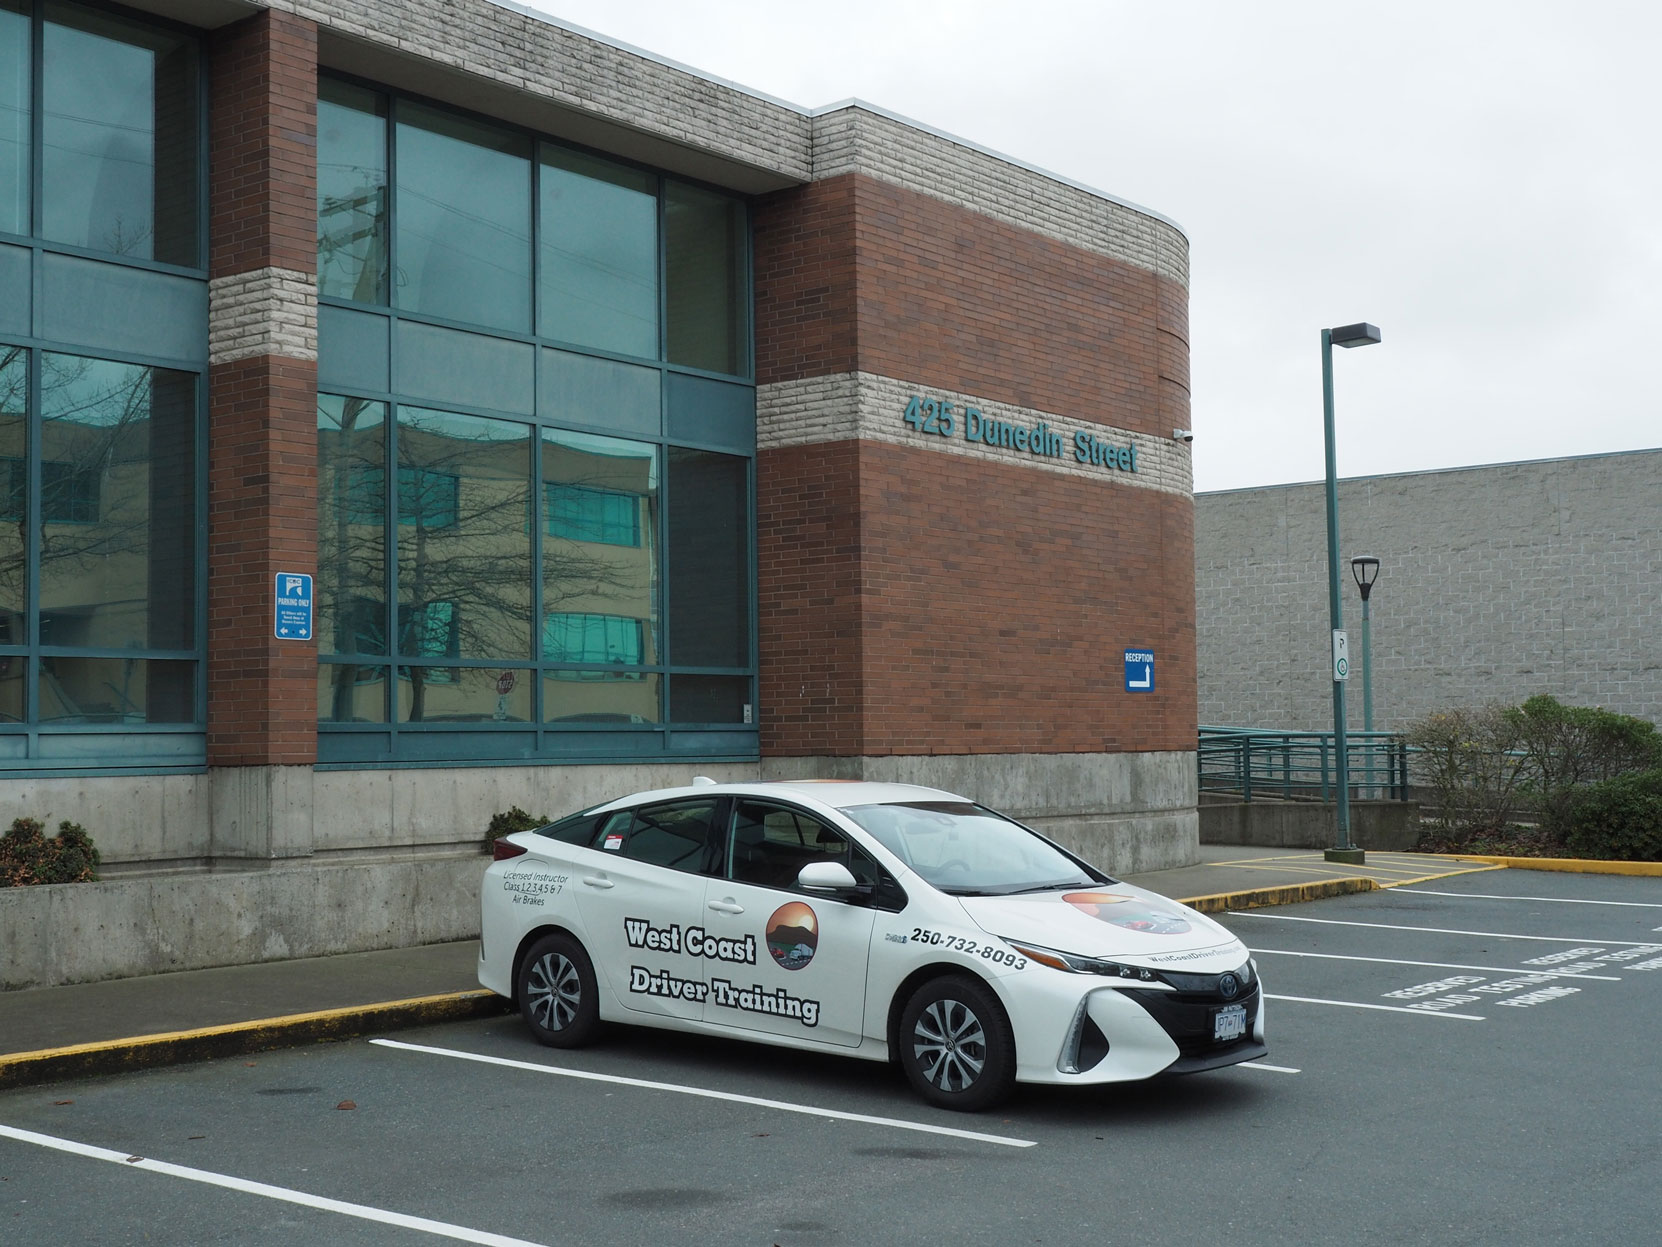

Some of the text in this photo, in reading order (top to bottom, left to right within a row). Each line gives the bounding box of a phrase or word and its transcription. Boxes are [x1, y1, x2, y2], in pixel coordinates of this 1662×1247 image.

[904, 396, 1138, 472] 425 Dunedin Street
[278, 597, 309, 607] PARKING ONLY
[1125, 652, 1154, 663] RECEPTION
[503, 870, 569, 884] Licensed Instructor
[503, 881, 520, 892] Class
[556, 885, 563, 895] 7
[511, 894, 545, 906] Air Brakes
[624, 917, 757, 965] West Coast
[910, 927, 1028, 971] 250-732-8093
[630, 965, 820, 1028] Driver Training
[1380, 975, 1487, 999] RESERVED
[1406, 974, 1559, 1010] ROAD TESTING
[1495, 986, 1582, 1008] PARKING
